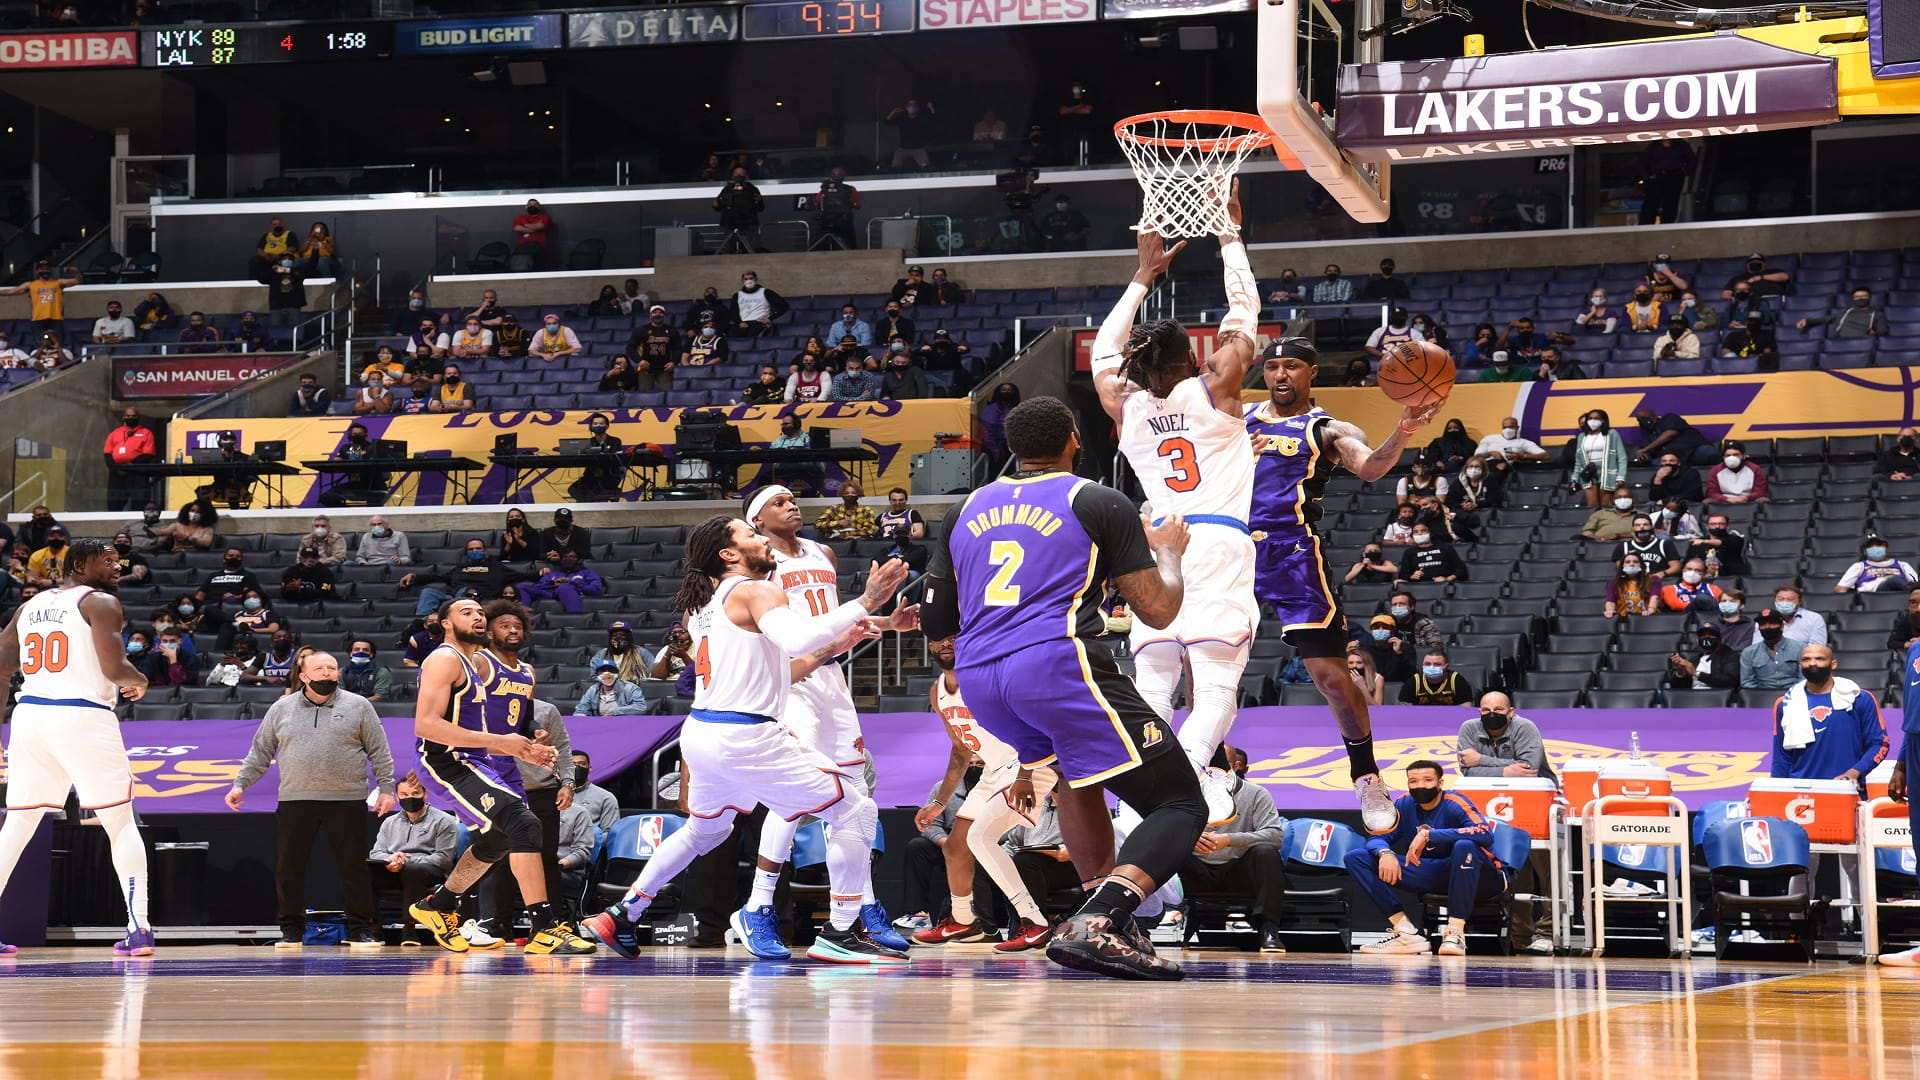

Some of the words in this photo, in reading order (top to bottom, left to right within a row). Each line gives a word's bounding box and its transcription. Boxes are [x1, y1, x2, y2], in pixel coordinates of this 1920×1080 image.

[802, 3, 880, 33] 9:34
[924, 0, 1090, 26] STAPLES
[156, 30, 202, 48] NYK
[211, 29, 235, 46] 89
[420, 31, 466, 46] BUD
[470, 27, 534, 44] LIGHT
[617, 16, 729, 39] DELTA
[0, 37, 133, 64] OSHIBA
[280, 35, 293, 51] 4
[326, 33, 366, 50] 1:58
[156, 49, 194, 66] LAL
[211, 48, 235, 64] 87
[1382, 70, 1758, 137] LAKERS.COM
[1386, 124, 1761, 161] LAKERS.COM
[1539, 159, 1566, 171] PR6
[136, 371, 168, 383] SAN
[171, 370, 234, 382] MANUEL
[1147, 413, 1190, 436] NOEL
[1157, 436, 1202, 493] 3
[966, 504, 1064, 538] DRUMMOND
[780, 570, 808, 589] NEW
[810, 569, 836, 584] YORK
[984, 540, 1025, 606] 2
[804, 588, 829, 617] 11
[29, 608, 68, 626] RANDLE
[22, 630, 69, 675] 30
[694, 635, 712, 690] 4
[506, 698, 521, 727] 9
[1485, 796, 1514, 822] G
[1785, 798, 1815, 824] G
[1611, 824, 1671, 834] GATORADE
